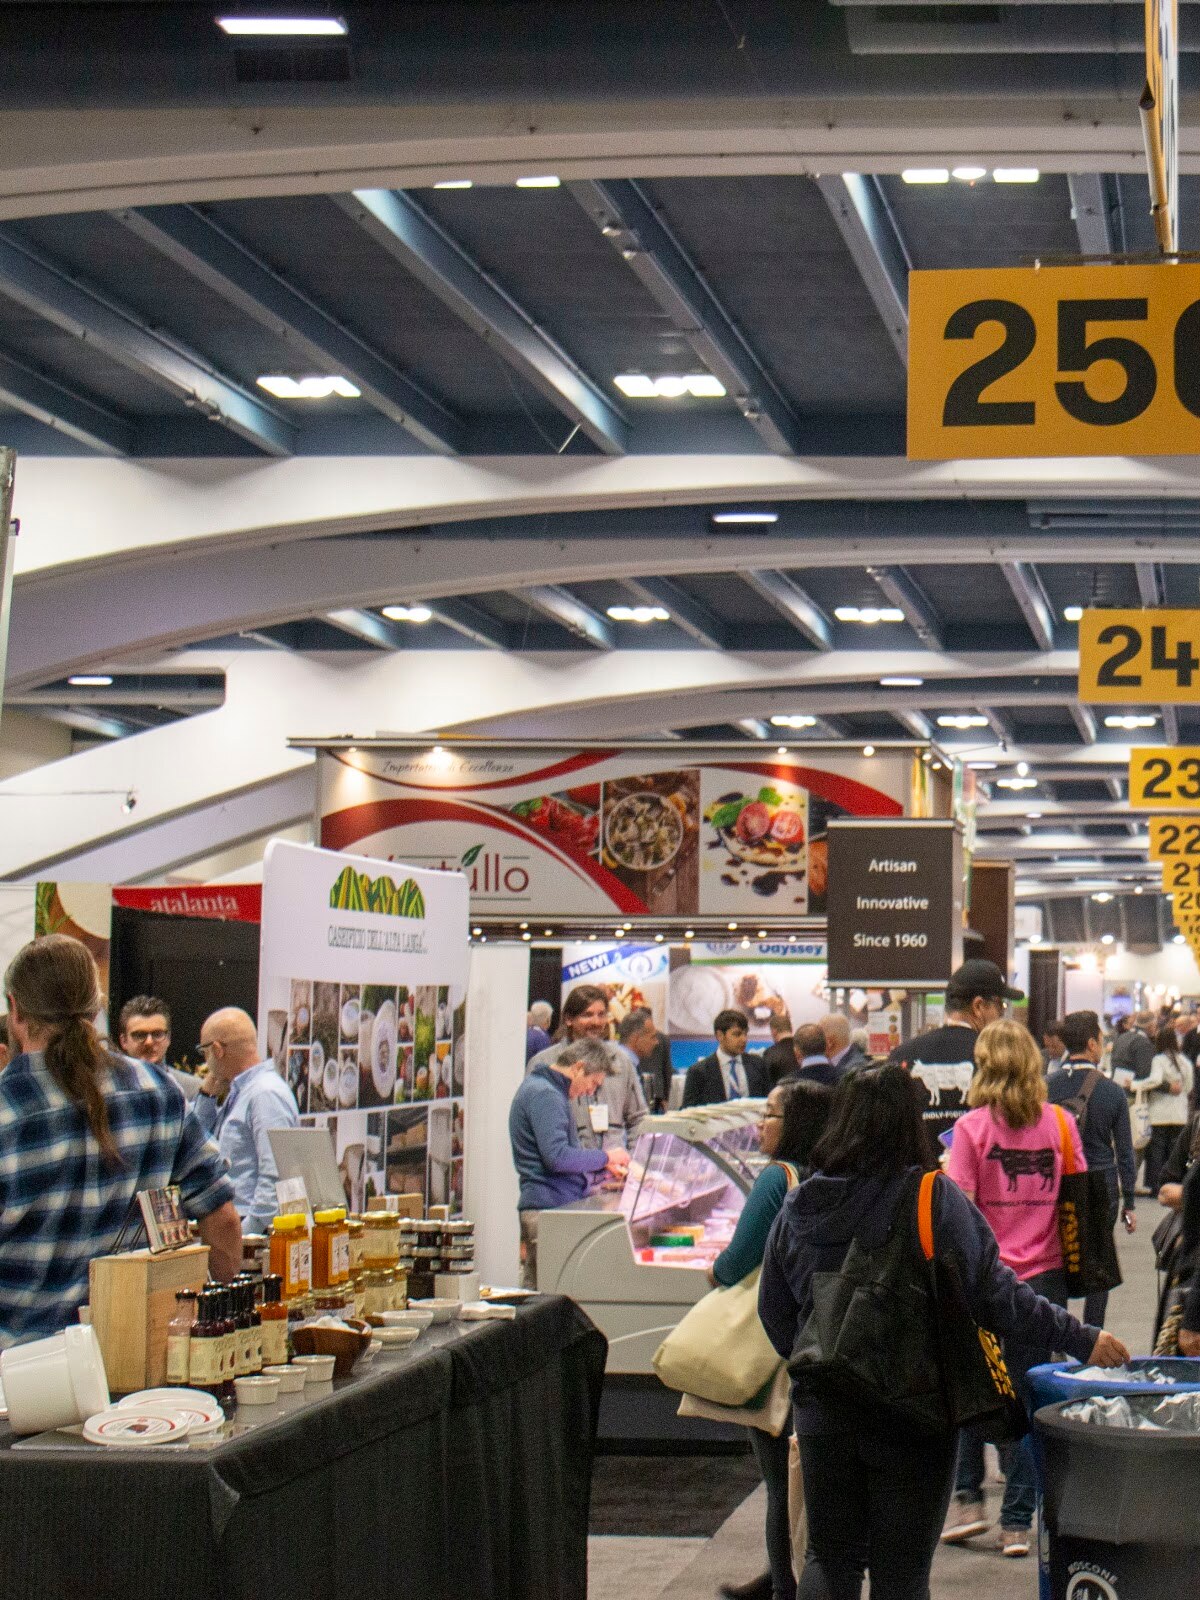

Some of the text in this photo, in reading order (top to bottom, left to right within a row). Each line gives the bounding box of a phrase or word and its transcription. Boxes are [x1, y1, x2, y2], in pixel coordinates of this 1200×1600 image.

[868, 859, 918, 873] Artisan
[150, 891, 239, 914] atalanta
[856, 896, 929, 910] Innovative
[853, 933, 928, 948] Since 1960
[758, 943, 823, 956] Odyssey
[567, 952, 611, 978] NEW!
[1067, 1561, 1119, 1585] MOSCONE
